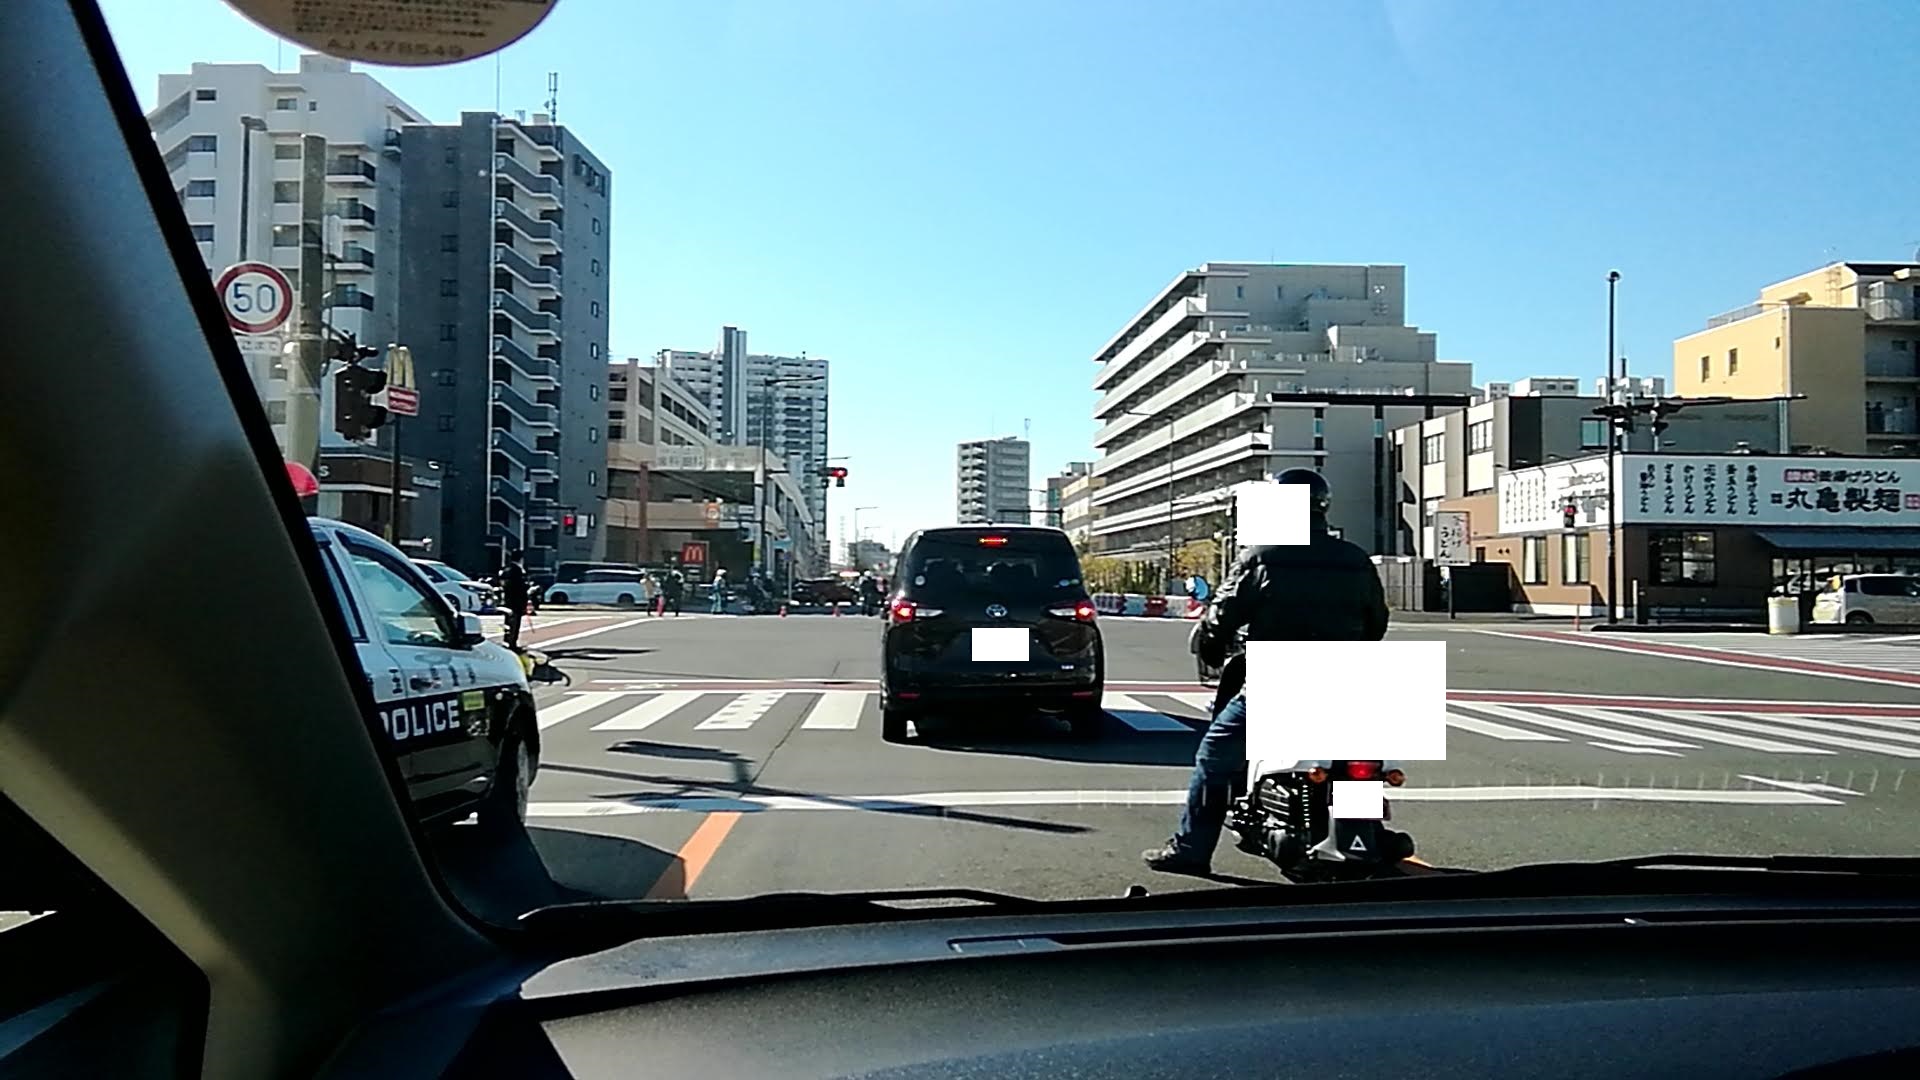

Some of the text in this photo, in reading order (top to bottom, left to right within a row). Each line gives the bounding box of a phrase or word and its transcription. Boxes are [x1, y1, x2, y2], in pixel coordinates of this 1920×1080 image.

[233, 283, 276, 313] 50
[1683, 465, 1695, 514] かけうどん
[1785, 487, 1901, 512] 丸亀製麺
